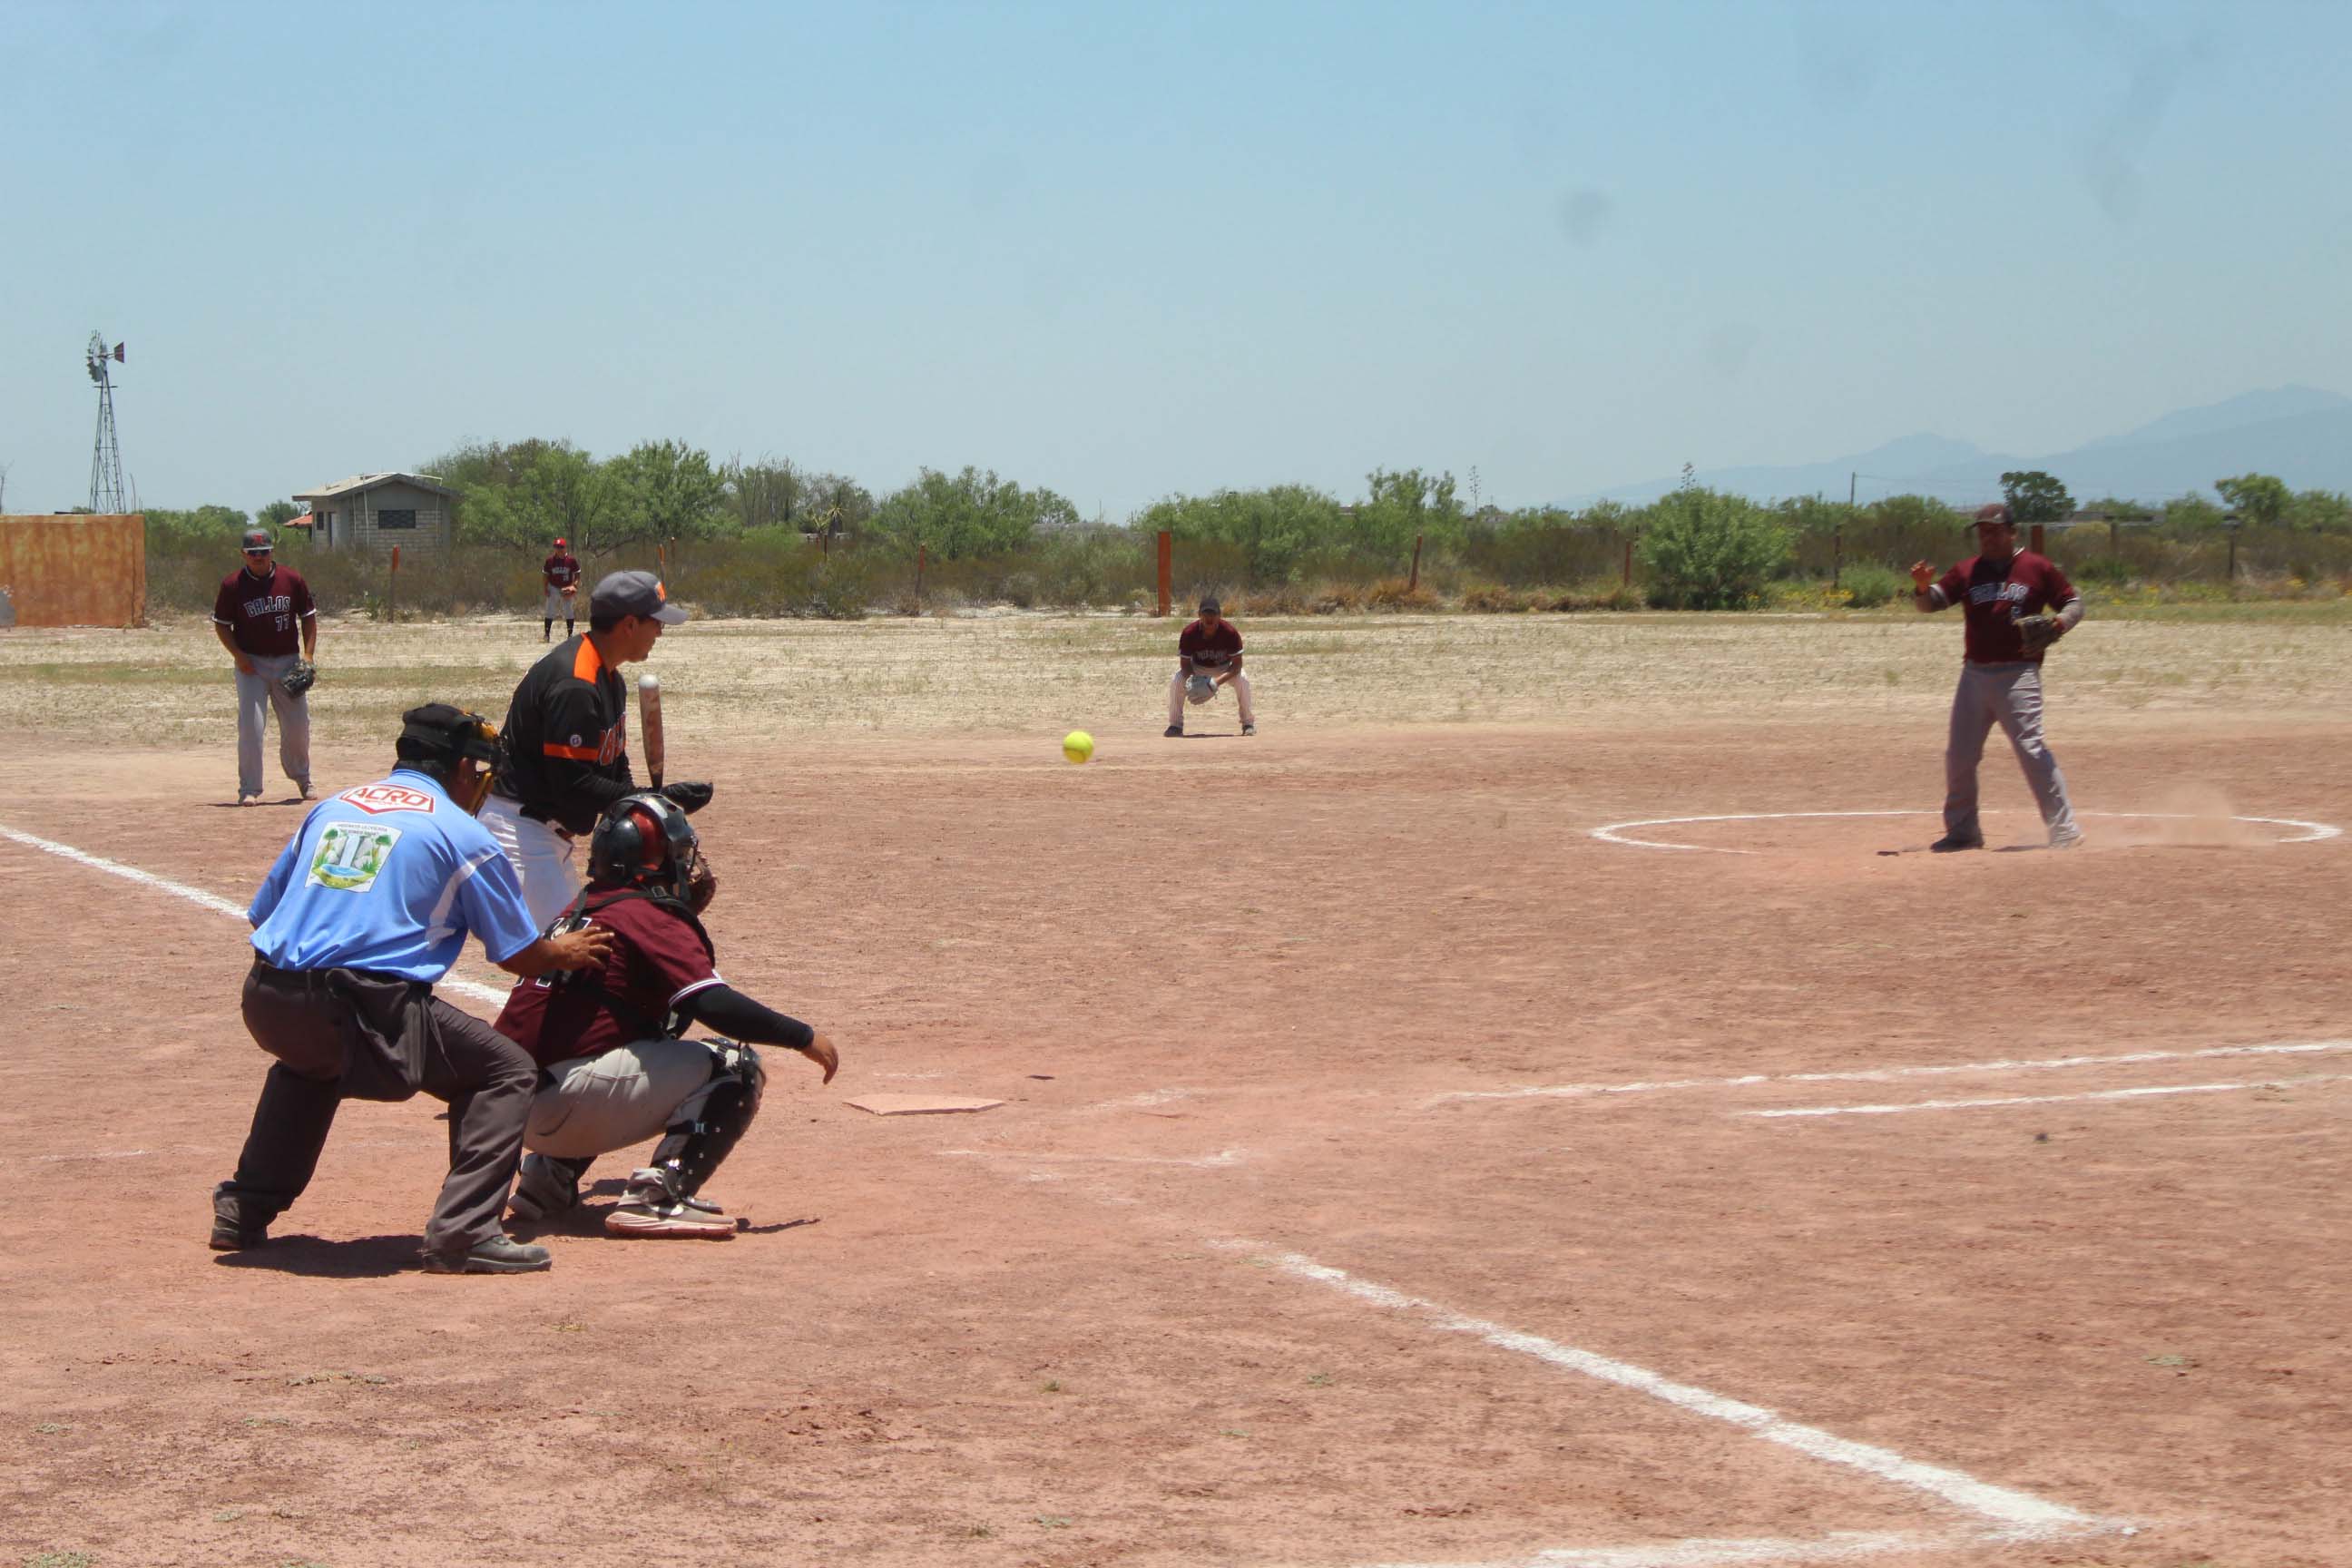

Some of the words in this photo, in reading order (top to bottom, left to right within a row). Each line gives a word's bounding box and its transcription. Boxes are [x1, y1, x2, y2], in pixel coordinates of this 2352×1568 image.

[244, 595, 290, 617] GALLOS
[275, 613, 289, 632] 77
[348, 788, 430, 807] ACRO
